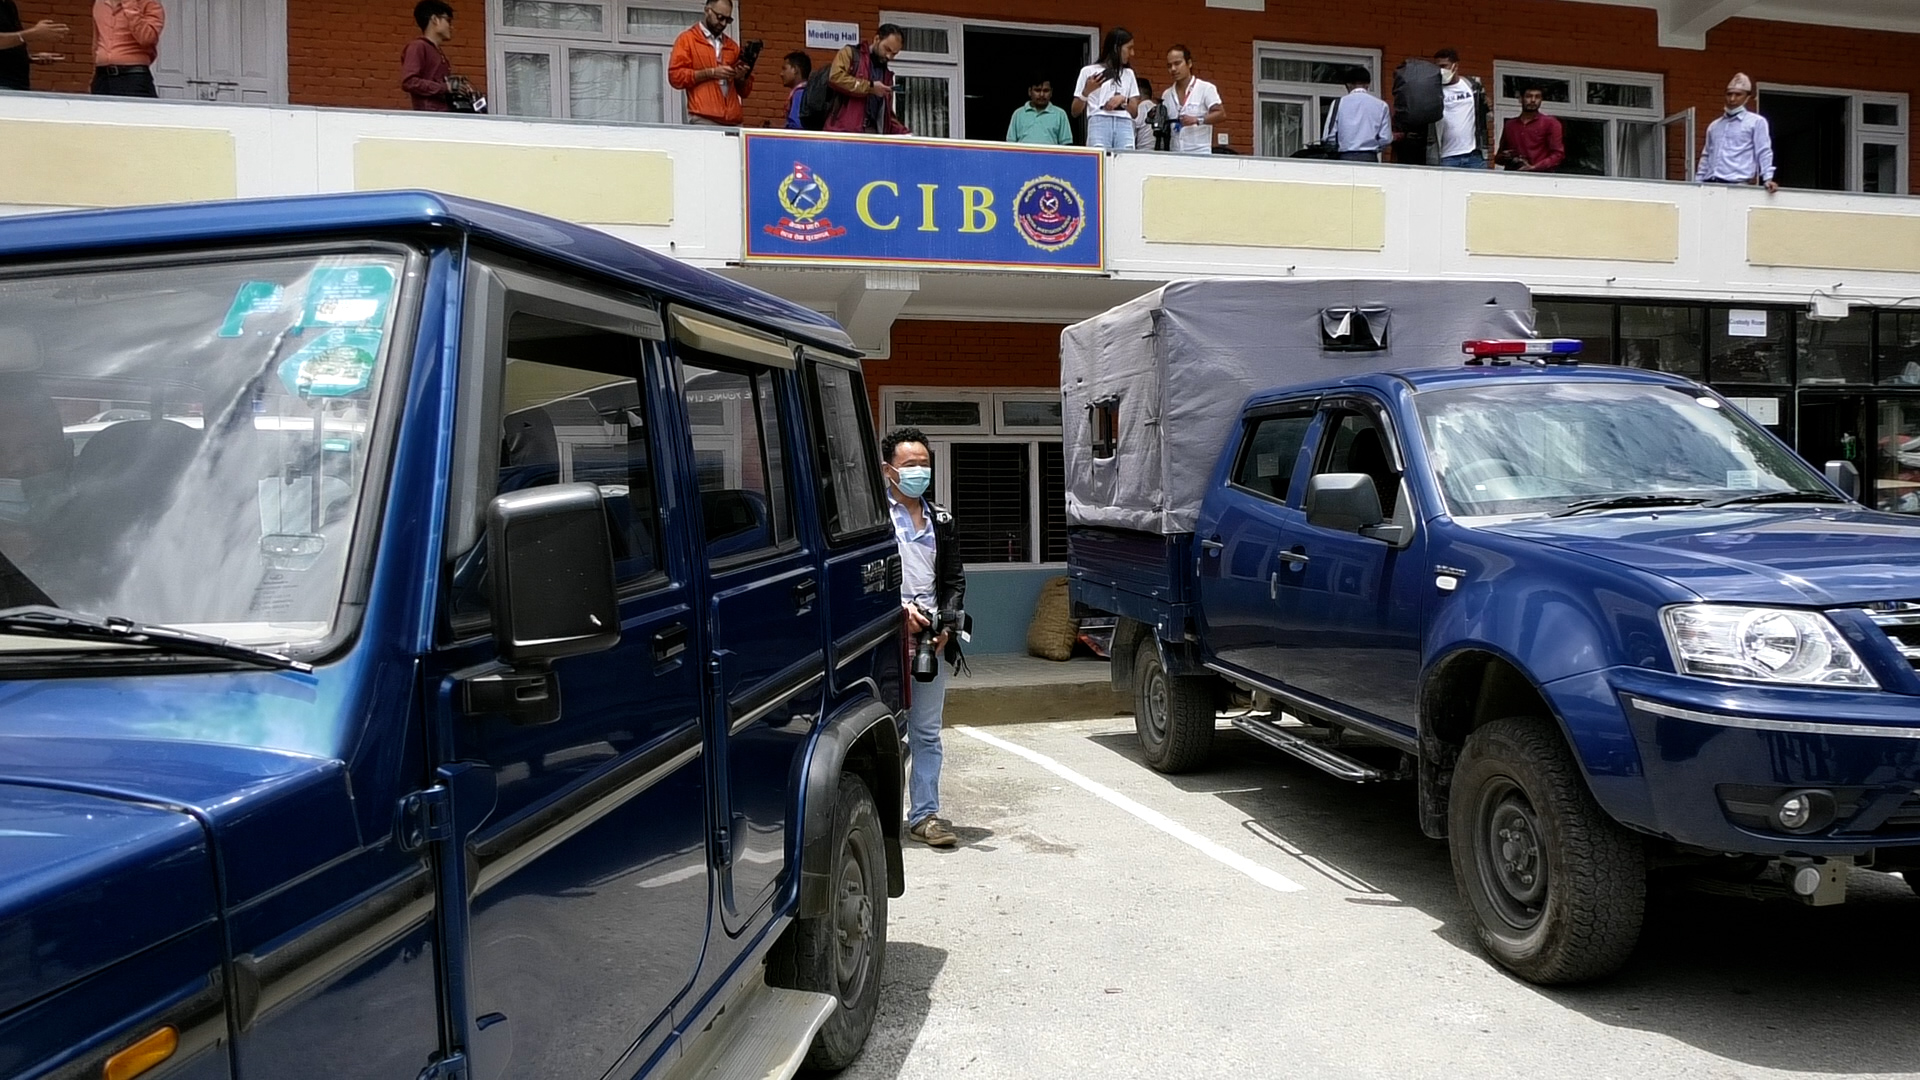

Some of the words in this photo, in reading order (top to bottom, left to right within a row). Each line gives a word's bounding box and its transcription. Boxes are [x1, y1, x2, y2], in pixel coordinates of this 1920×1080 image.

[808, 29, 839, 42] Meeting
[841, 31, 857, 41] Hall
[855, 180, 997, 234] CIB
